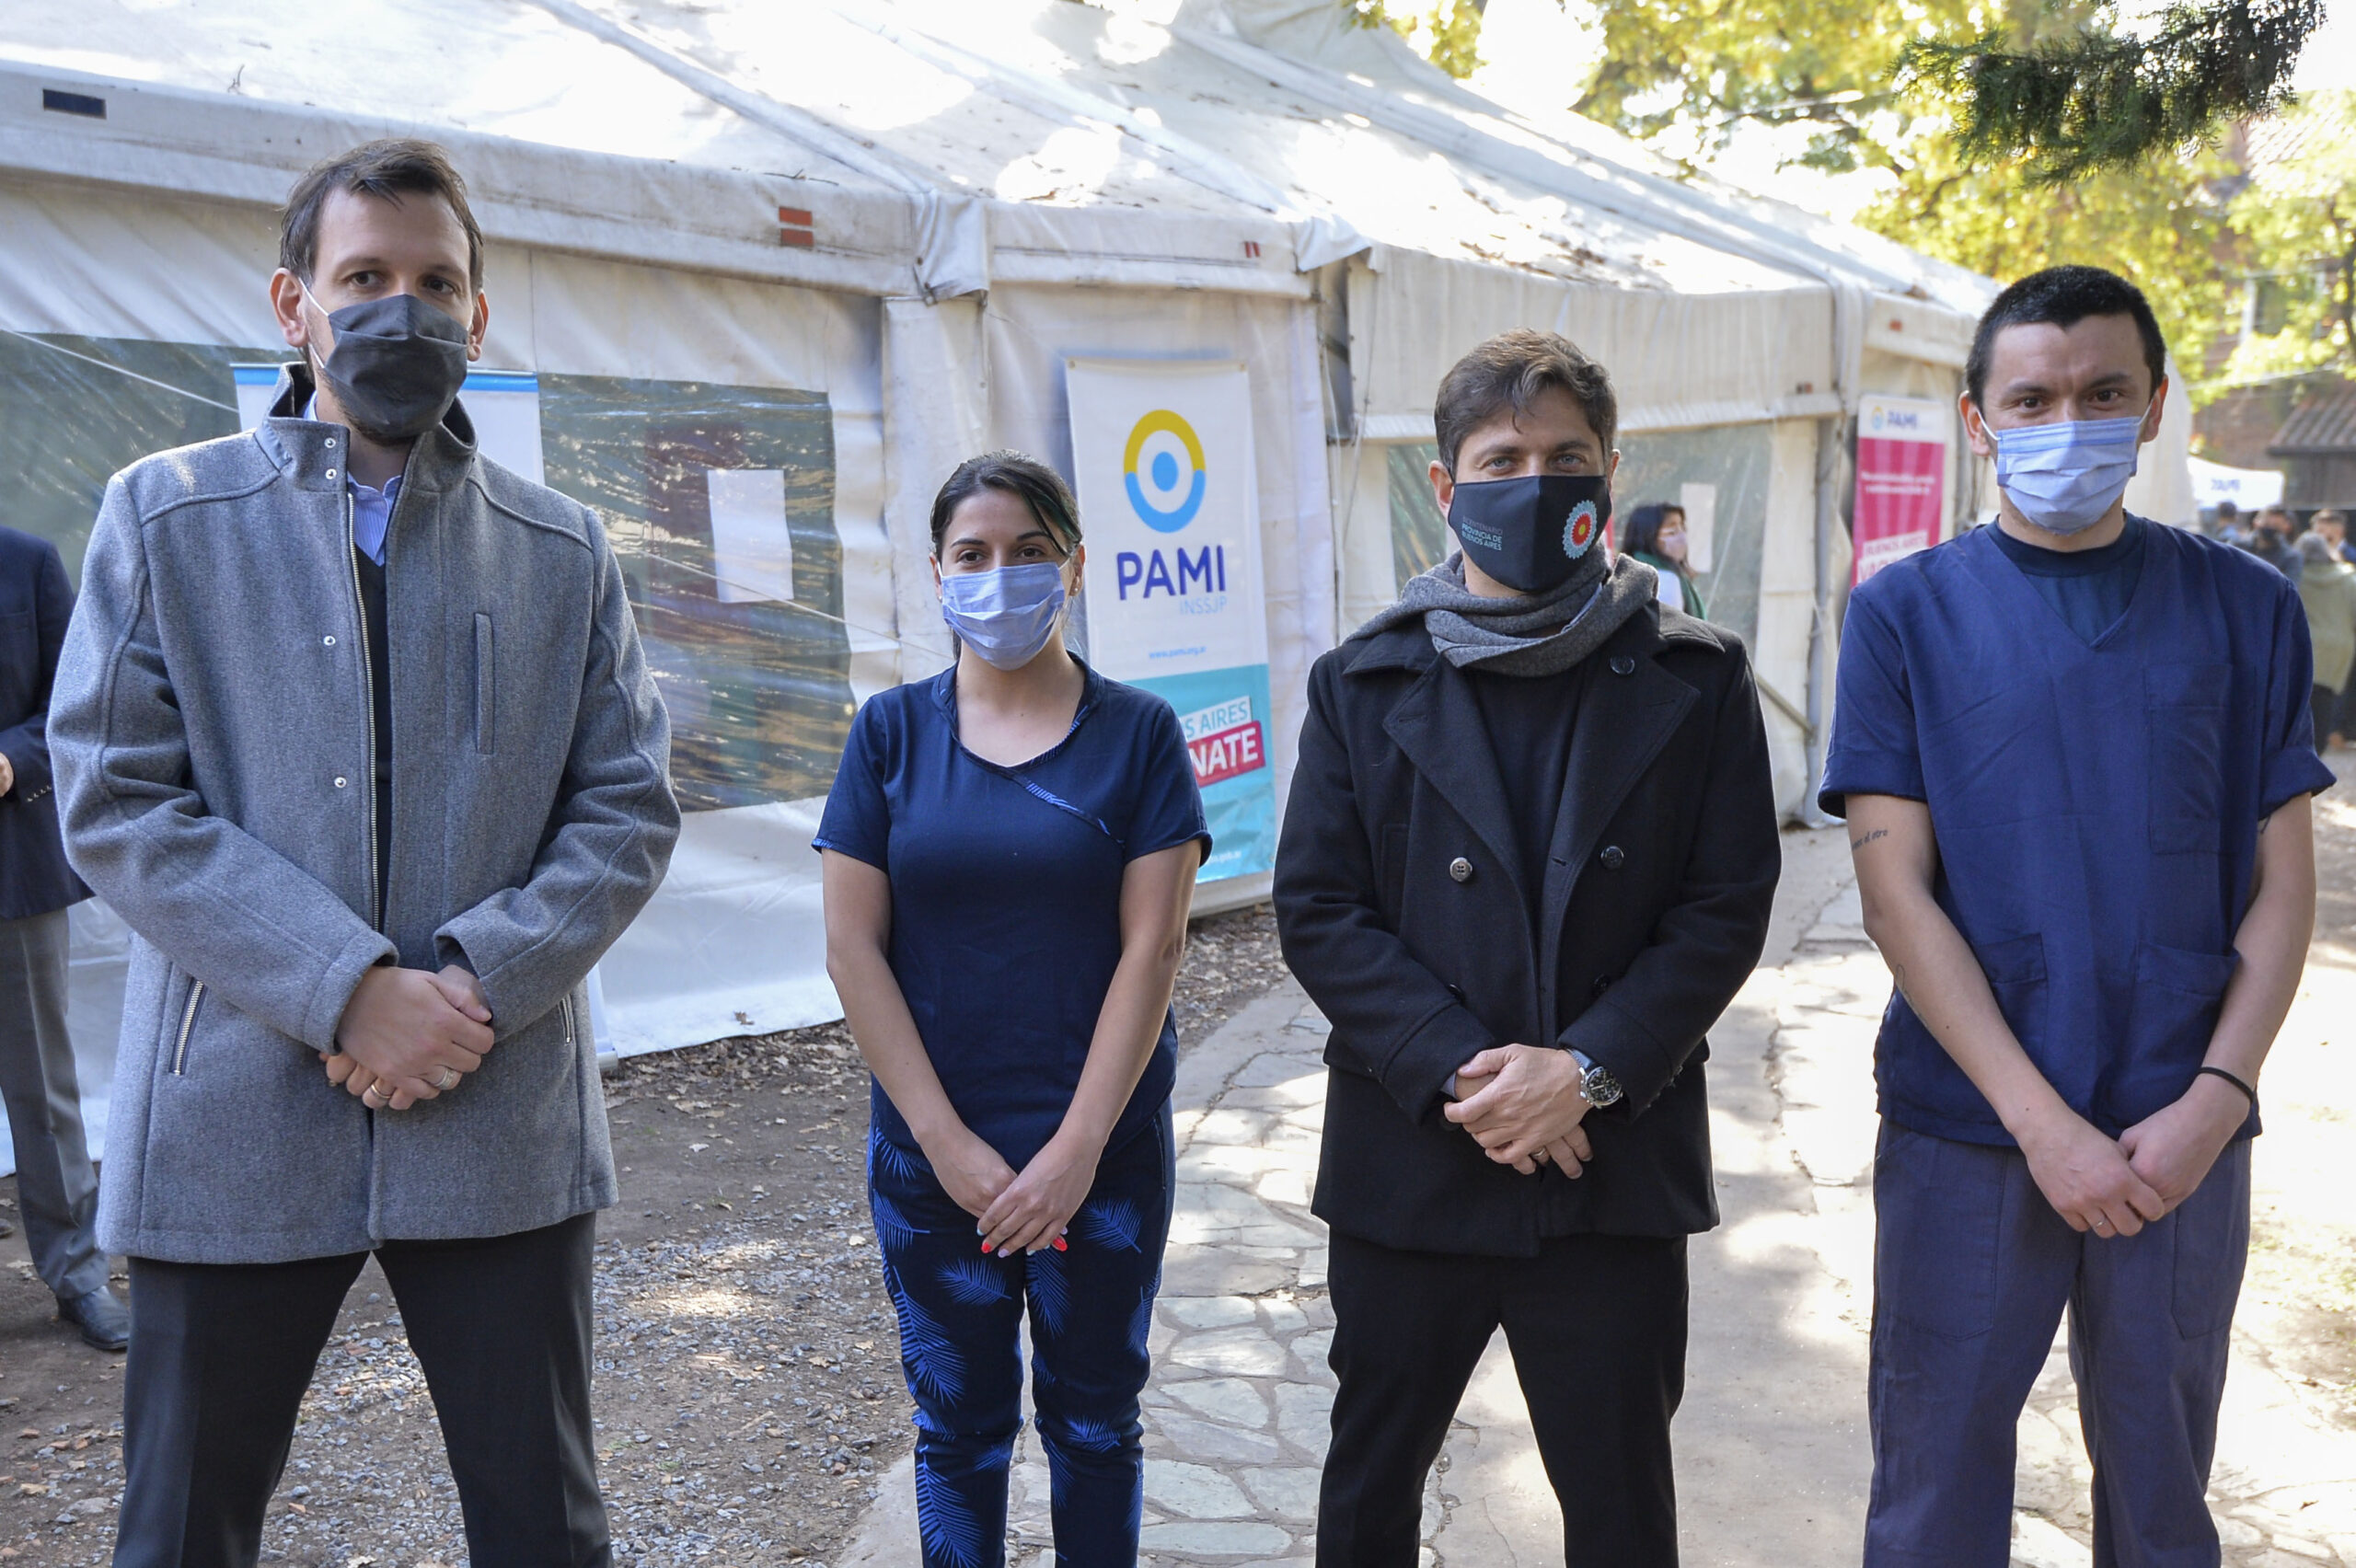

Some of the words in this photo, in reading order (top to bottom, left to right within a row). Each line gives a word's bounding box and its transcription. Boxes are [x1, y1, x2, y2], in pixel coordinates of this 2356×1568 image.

[1461, 522, 1491, 540] PROVINCIA
[1492, 535, 1502, 544] DE
[1461, 530, 1483, 546] BUENOS
[1484, 540, 1502, 551] AIRES
[1117, 545, 1226, 600] PAMI
[1180, 595, 1228, 615] INSSJP
[1199, 700, 1248, 733] AIRES
